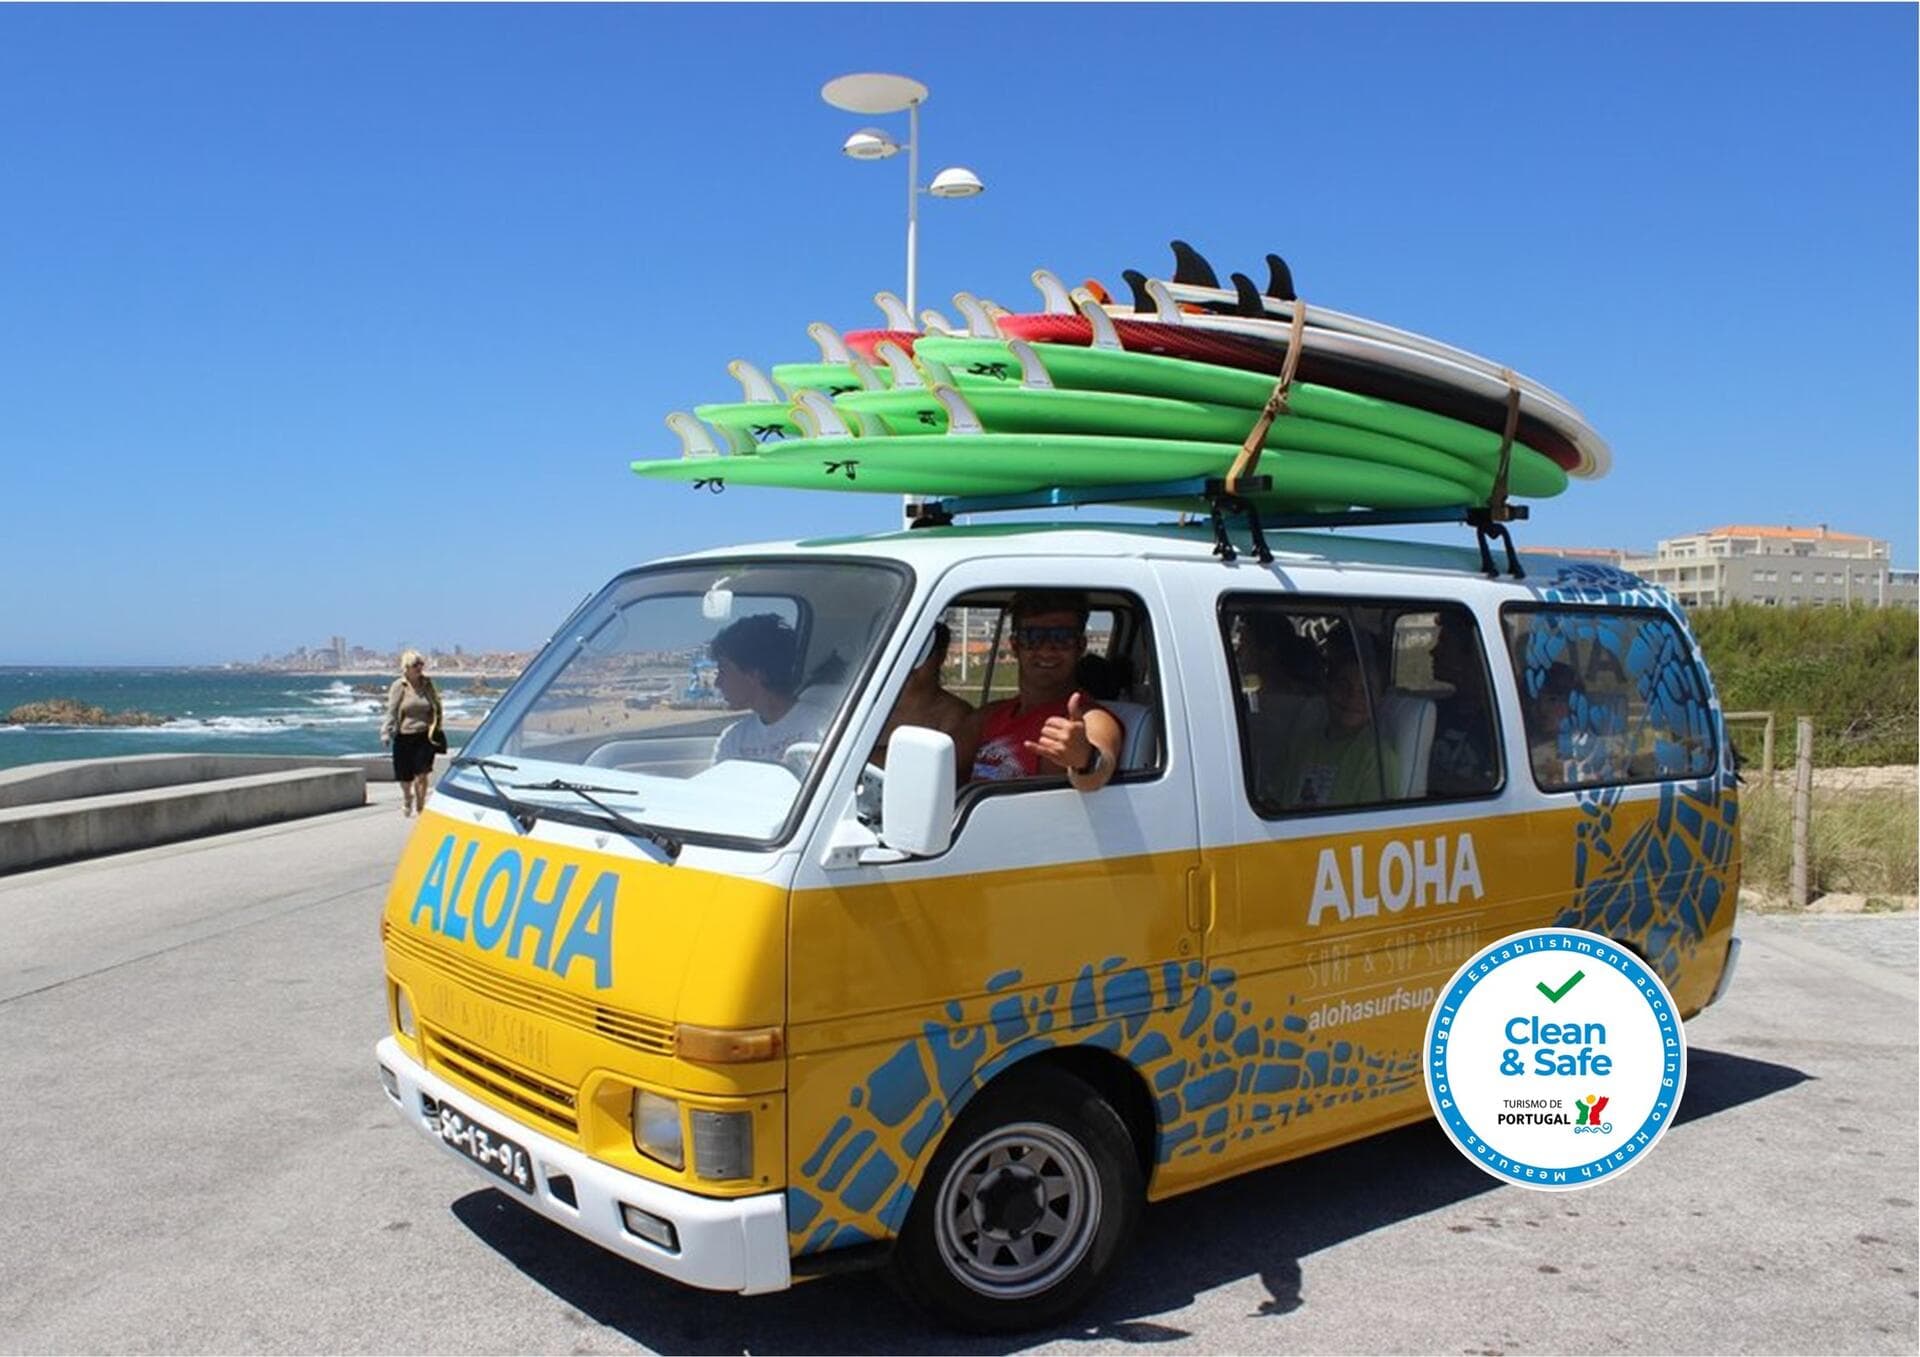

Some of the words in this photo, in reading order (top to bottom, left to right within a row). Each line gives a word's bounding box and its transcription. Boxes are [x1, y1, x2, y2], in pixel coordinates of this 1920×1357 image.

[409, 834, 620, 989] ALOHA
[1307, 832, 1484, 926] ALOHA
[1305, 943, 1352, 990] SURF
[1363, 948, 1376, 973] &
[1385, 933, 1416, 975] SUP
[1424, 920, 1479, 967] SCHOOL
